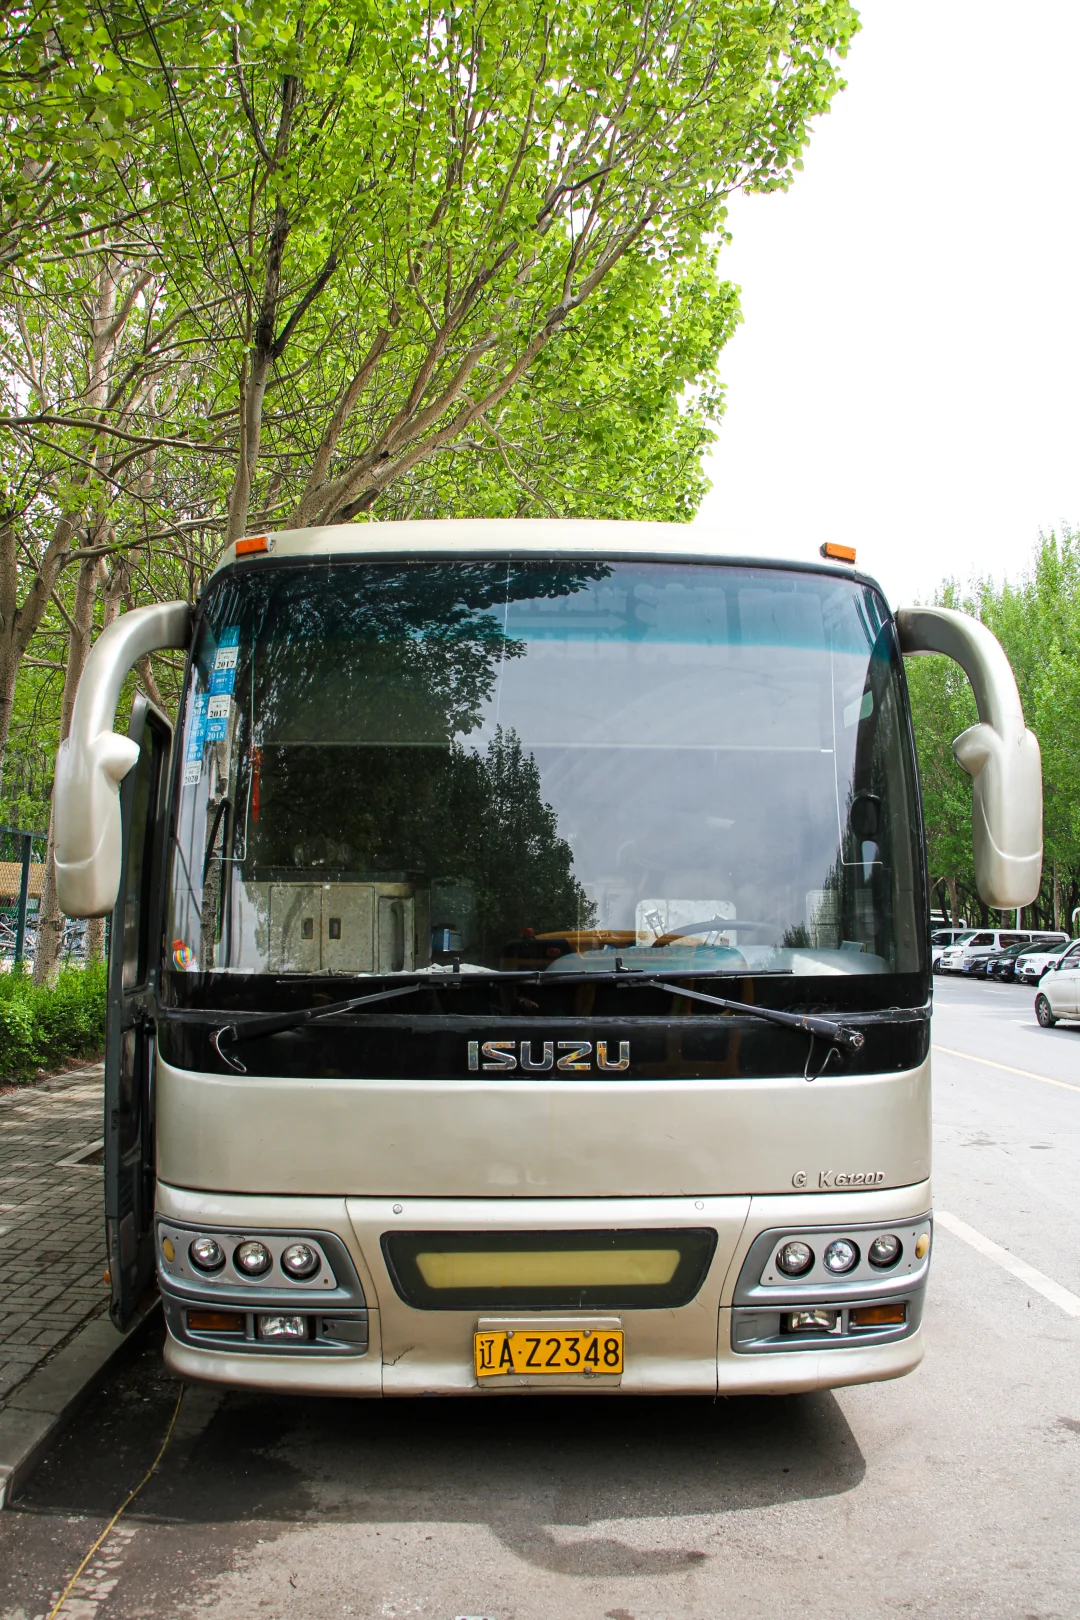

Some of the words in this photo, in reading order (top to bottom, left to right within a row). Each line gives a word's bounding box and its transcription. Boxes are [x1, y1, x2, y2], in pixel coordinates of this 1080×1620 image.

[216, 660, 235, 669] 2017
[209, 709, 228, 718] 2017
[207, 731, 225, 740] 2018
[184, 774, 199, 784] 2020
[467, 1041, 630, 1071] ISUZU
